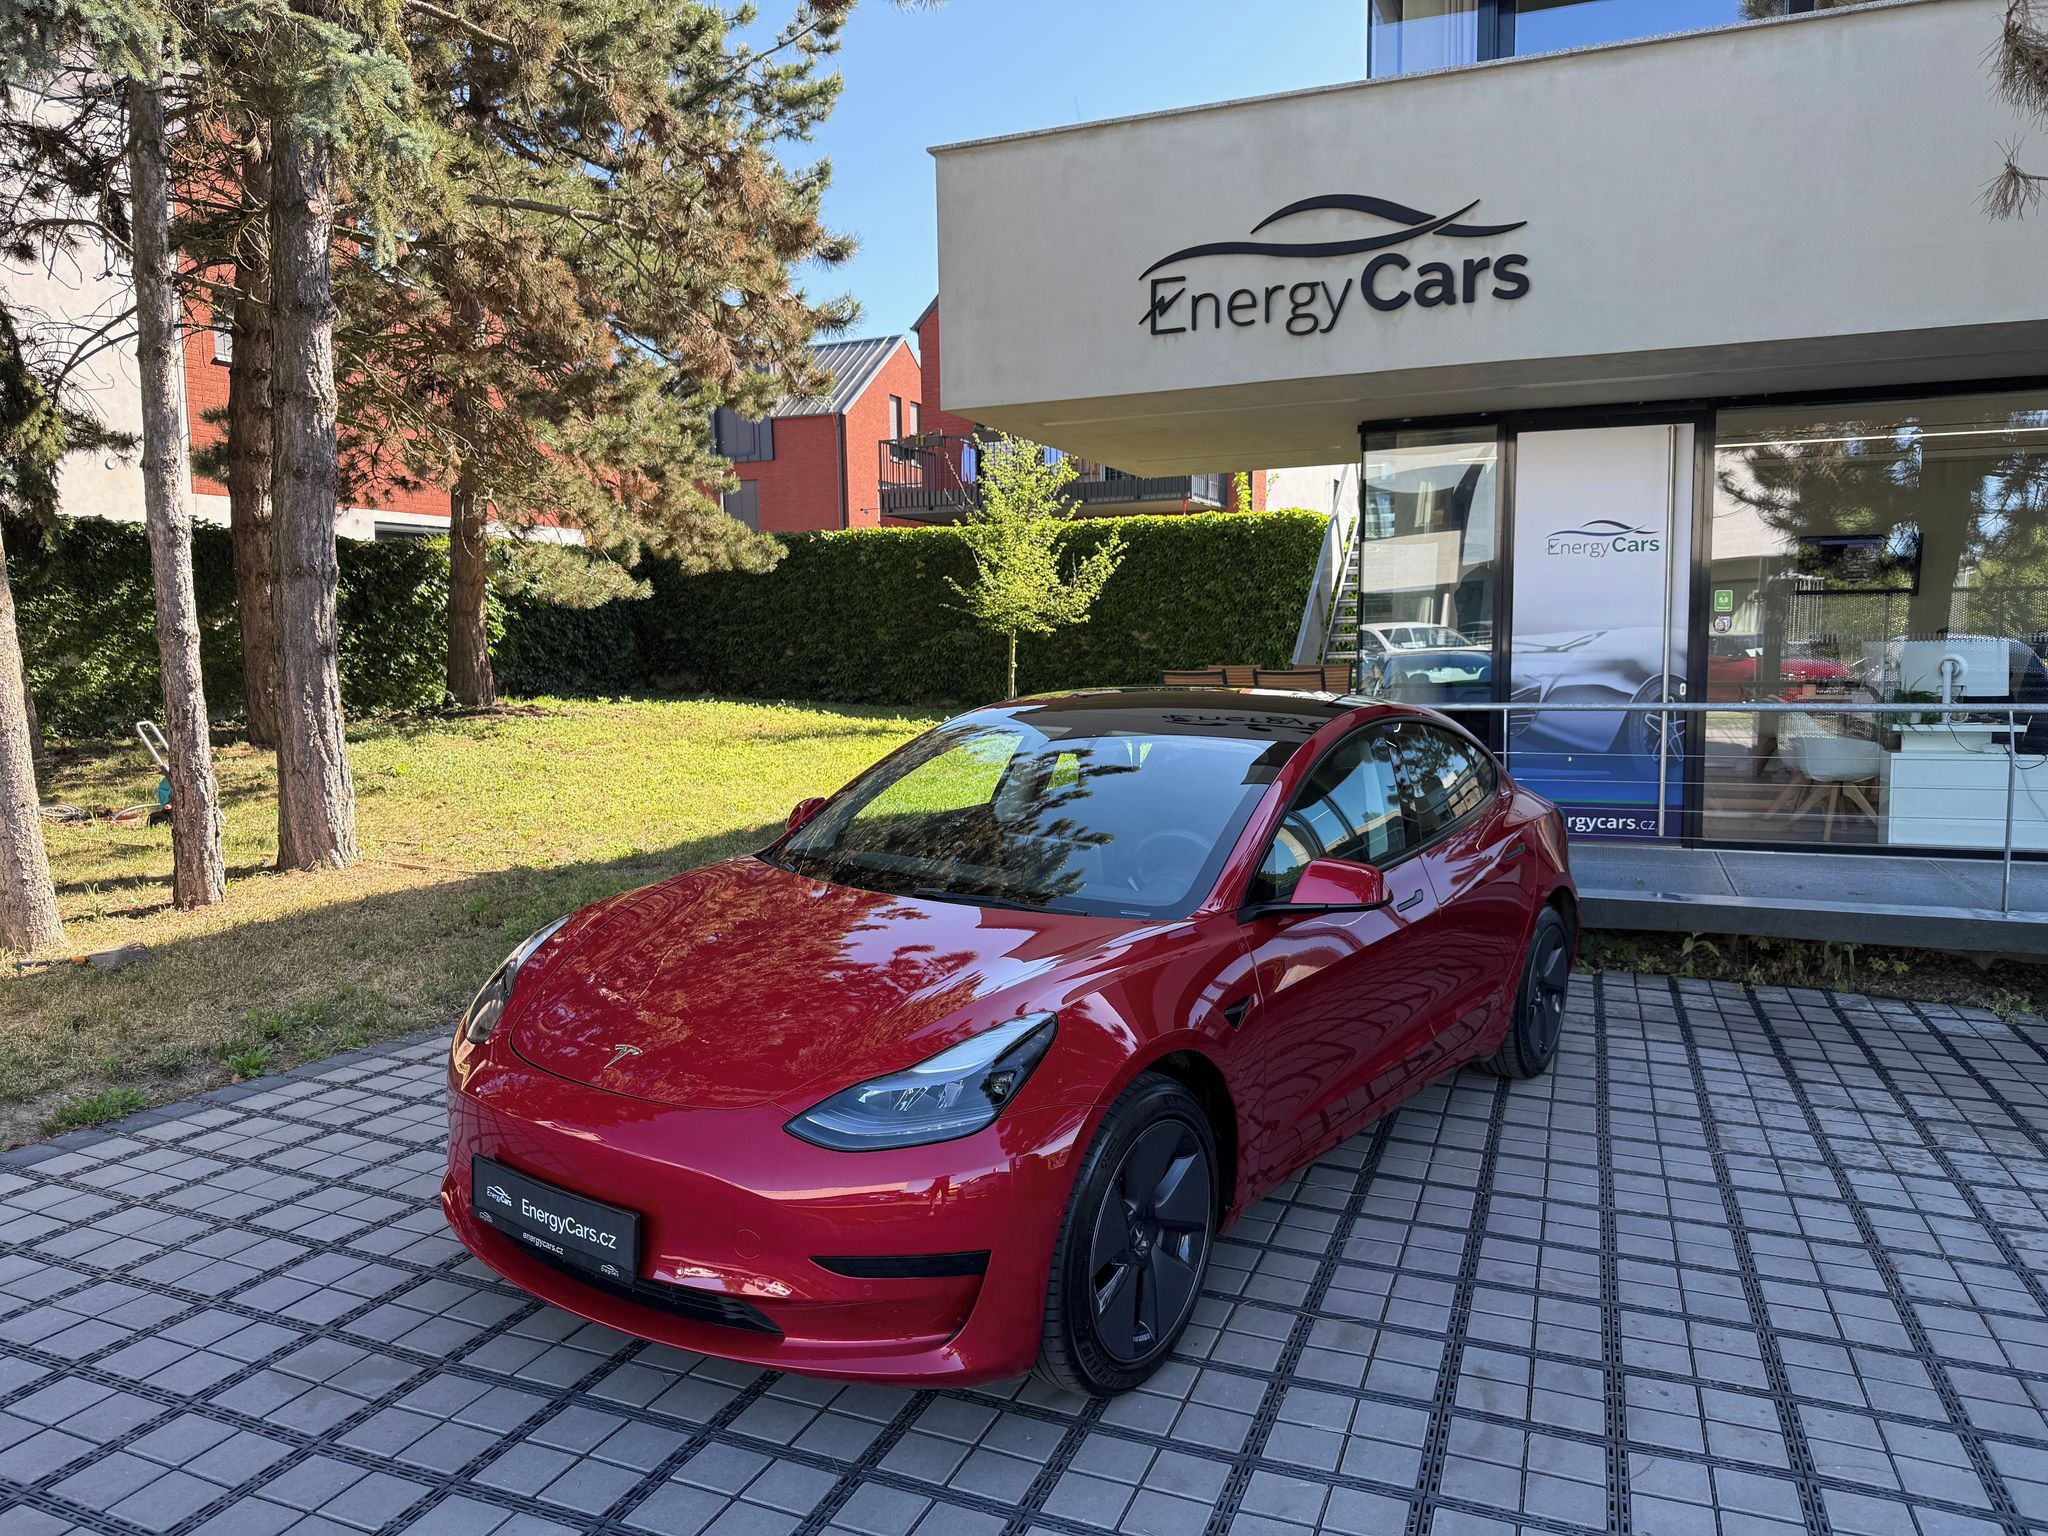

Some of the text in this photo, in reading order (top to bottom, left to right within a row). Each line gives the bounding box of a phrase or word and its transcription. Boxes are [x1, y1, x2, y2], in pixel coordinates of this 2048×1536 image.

[1140, 252, 1531, 336] EnergyCars
[1546, 536, 1660, 558] EnergyCars
[1567, 815, 1656, 833] rgycars.cz
[521, 1198, 617, 1250] EnergyCars.cz
[522, 1231, 564, 1255] energycars.cz
